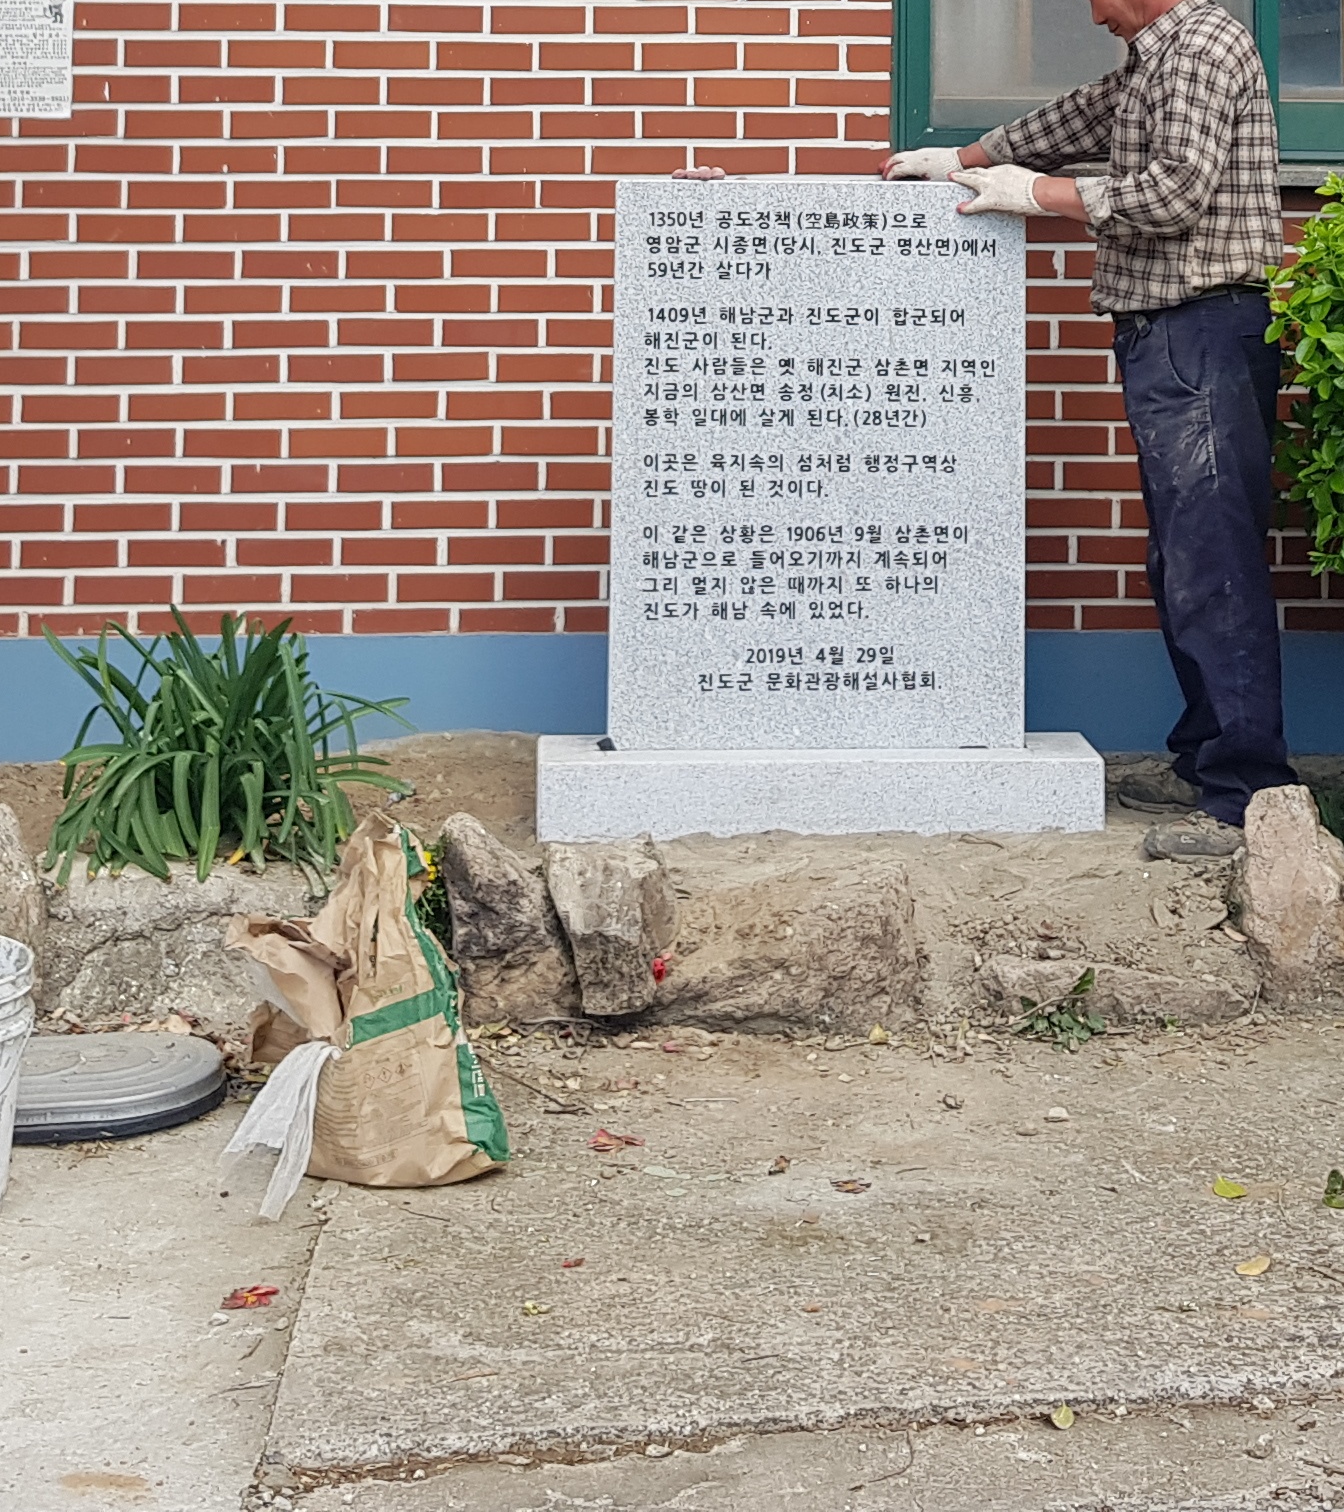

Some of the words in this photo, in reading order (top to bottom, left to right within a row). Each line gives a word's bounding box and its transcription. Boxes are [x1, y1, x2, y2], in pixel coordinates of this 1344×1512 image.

[649, 211, 704, 229] 1350년
[646, 235, 701, 254] 영암군
[830, 237, 886, 255] 진도군
[648, 261, 704, 279] 59년간
[716, 261, 771, 280] 살다가
[648, 306, 706, 325] 1409년
[719, 306, 794, 325] 해남군과
[806, 307, 879, 326] 진도군이
[892, 307, 965, 326] 합군되어
[643, 331, 718, 350] 해진군이
[730, 331, 773, 350] 된다.
[644, 357, 679, 375] 진도
[692, 357, 766, 376] 사람들은
[807, 358, 863, 377] 해진군
[874, 358, 929, 377] 삼촌면
[941, 359, 995, 378] 지역인
[644, 382, 698, 401] 지금의
[710, 382, 765, 401] 삼산면
[643, 407, 679, 426] 봉학
[692, 408, 747, 426] 일대에
[758, 408, 794, 427] 살게
[643, 453, 699, 472] 이곳은
[710, 453, 784, 472] 육지속의
[797, 453, 851, 473] 섬처럼
[863, 454, 957, 473] 행정구역상
[643, 479, 679, 498] 진도
[691, 478, 726, 498] 땅이
[739, 479, 755, 498] 된
[768, 479, 829, 499] 것이다.
[643, 524, 658, 543] 이
[672, 524, 707, 544] 같은
[719, 524, 775, 544] 상황은
[786, 524, 844, 544] 1906년
[854, 524, 882, 544] 9월
[895, 524, 968, 545] 삼촌면이
[642, 550, 738, 570] 해남군으로
[749, 549, 861, 569] 들어오기까지
[873, 549, 947, 569] 계속되어
[642, 576, 678, 596] 그리
[692, 575, 727, 596] 멀지
[740, 575, 776, 595] 않은
[787, 575, 843, 595] 때까지
[855, 576, 872, 592] 또
[884, 575, 938, 595] 하나의
[643, 601, 699, 621] 진도가
[711, 601, 748, 620] 해남
[760, 600, 796, 620] 속에
[808, 600, 870, 620] 있었다.
[745, 646, 804, 666] 2019년
[815, 645, 844, 666] 4월
[856, 645, 895, 665] 29일
[697, 672, 754, 692] 진도군
